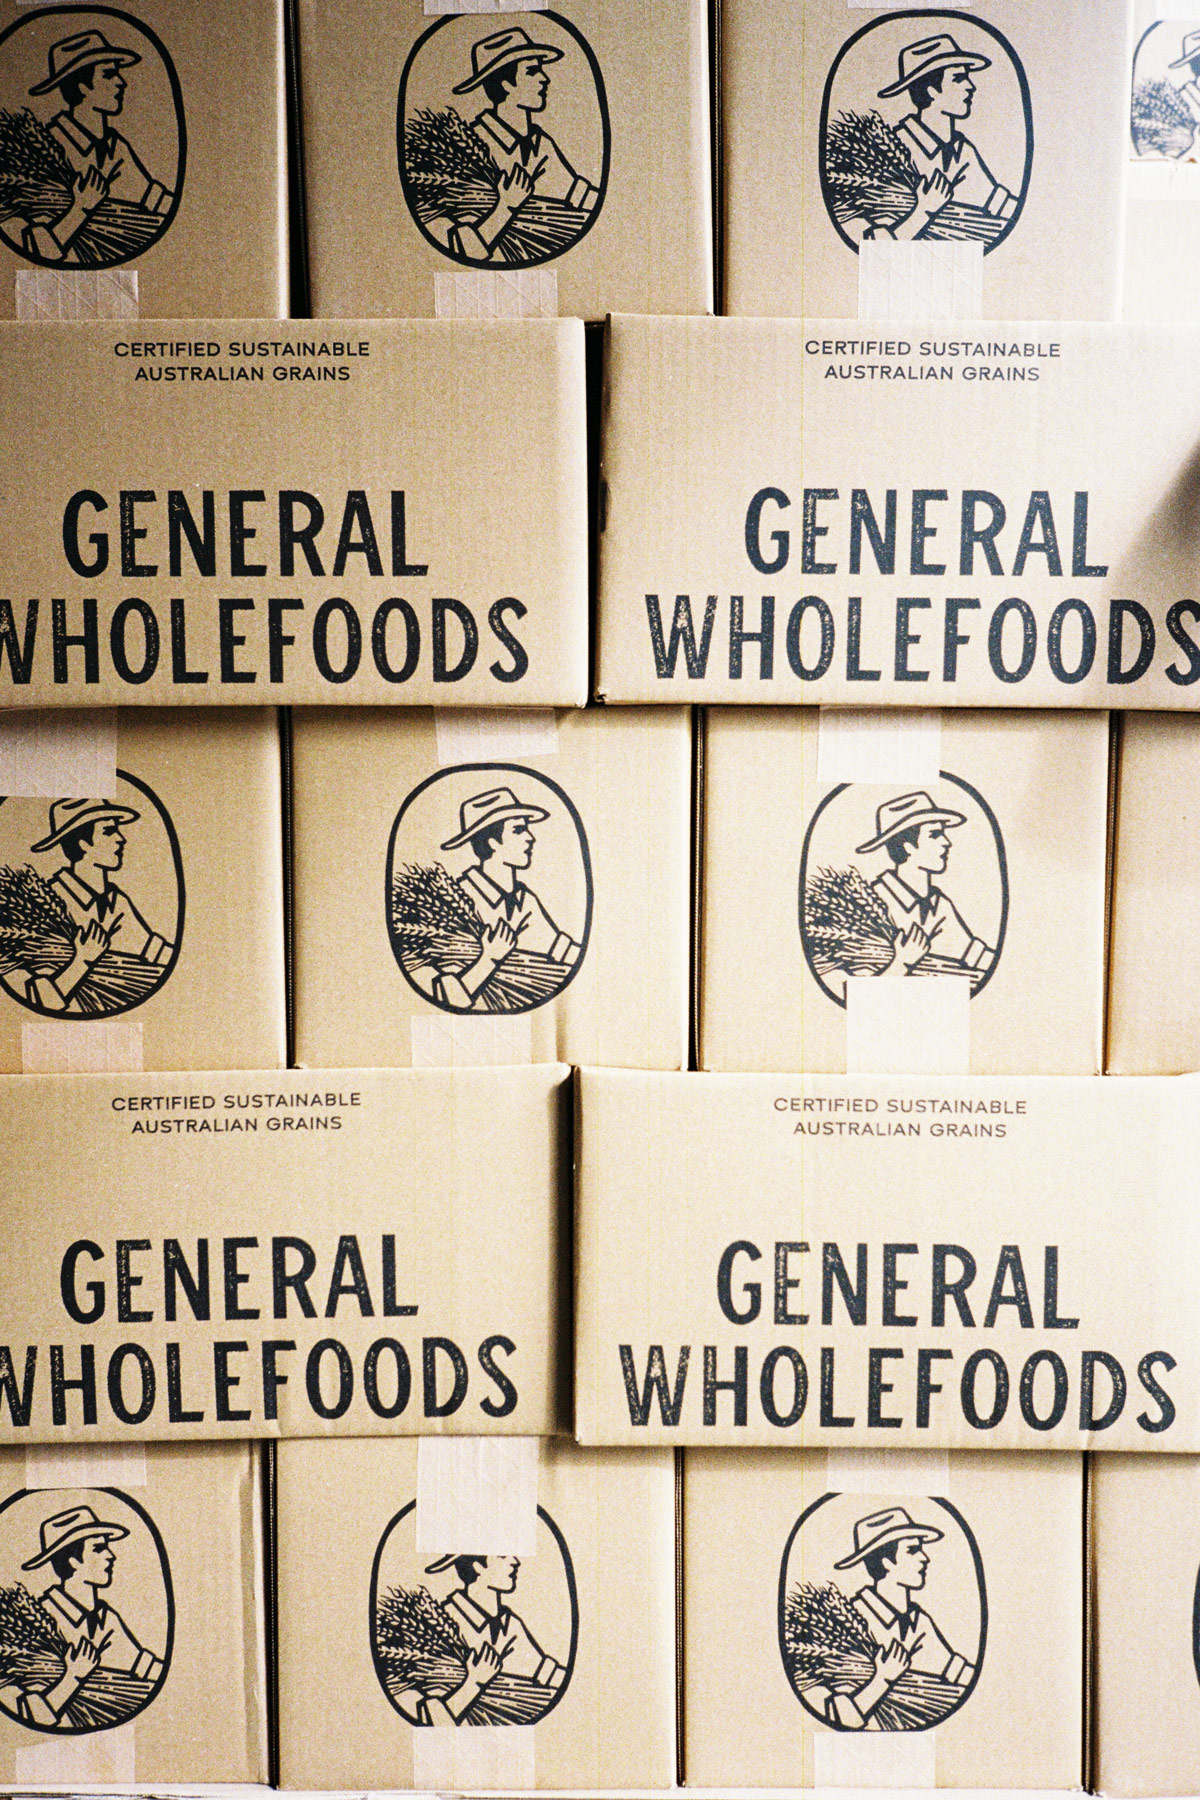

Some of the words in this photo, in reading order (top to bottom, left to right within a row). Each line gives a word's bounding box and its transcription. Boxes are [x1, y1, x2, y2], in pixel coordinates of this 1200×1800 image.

[114, 342, 220, 357] CERTIFIED
[229, 342, 369, 357] SUSTAINABLE
[805, 340, 911, 355] CERTIFIED
[920, 342, 1060, 357] SUSTAINABLE
[135, 367, 263, 381] AUSTRALIAN
[273, 366, 350, 381] GRAINS
[824, 365, 953, 379] AUSTRALIAN
[962, 366, 1039, 381] GRAINS
[62, 489, 428, 578] GENERAL
[745, 487, 1108, 577] GENERAL
[645, 594, 1200, 686] WHOLEFOODS
[112, 1096, 215, 1111] CERTIFIED
[224, 1093, 360, 1109] SUSTAINABLE
[774, 1098, 878, 1112] CERTIFIED
[887, 1099, 1026, 1114] SUSTAINABLE
[131, 1119, 257, 1134] AUSTRALIAN
[266, 1116, 342, 1131] GRAINS
[794, 1121, 920, 1136] AUSTRALIAN
[930, 1123, 1006, 1138] GRAINS
[60, 1235, 418, 1324] GENERAL
[717, 1240, 1079, 1329] GENERAL
[619, 1345, 1177, 1433] WHOLEFOODS
